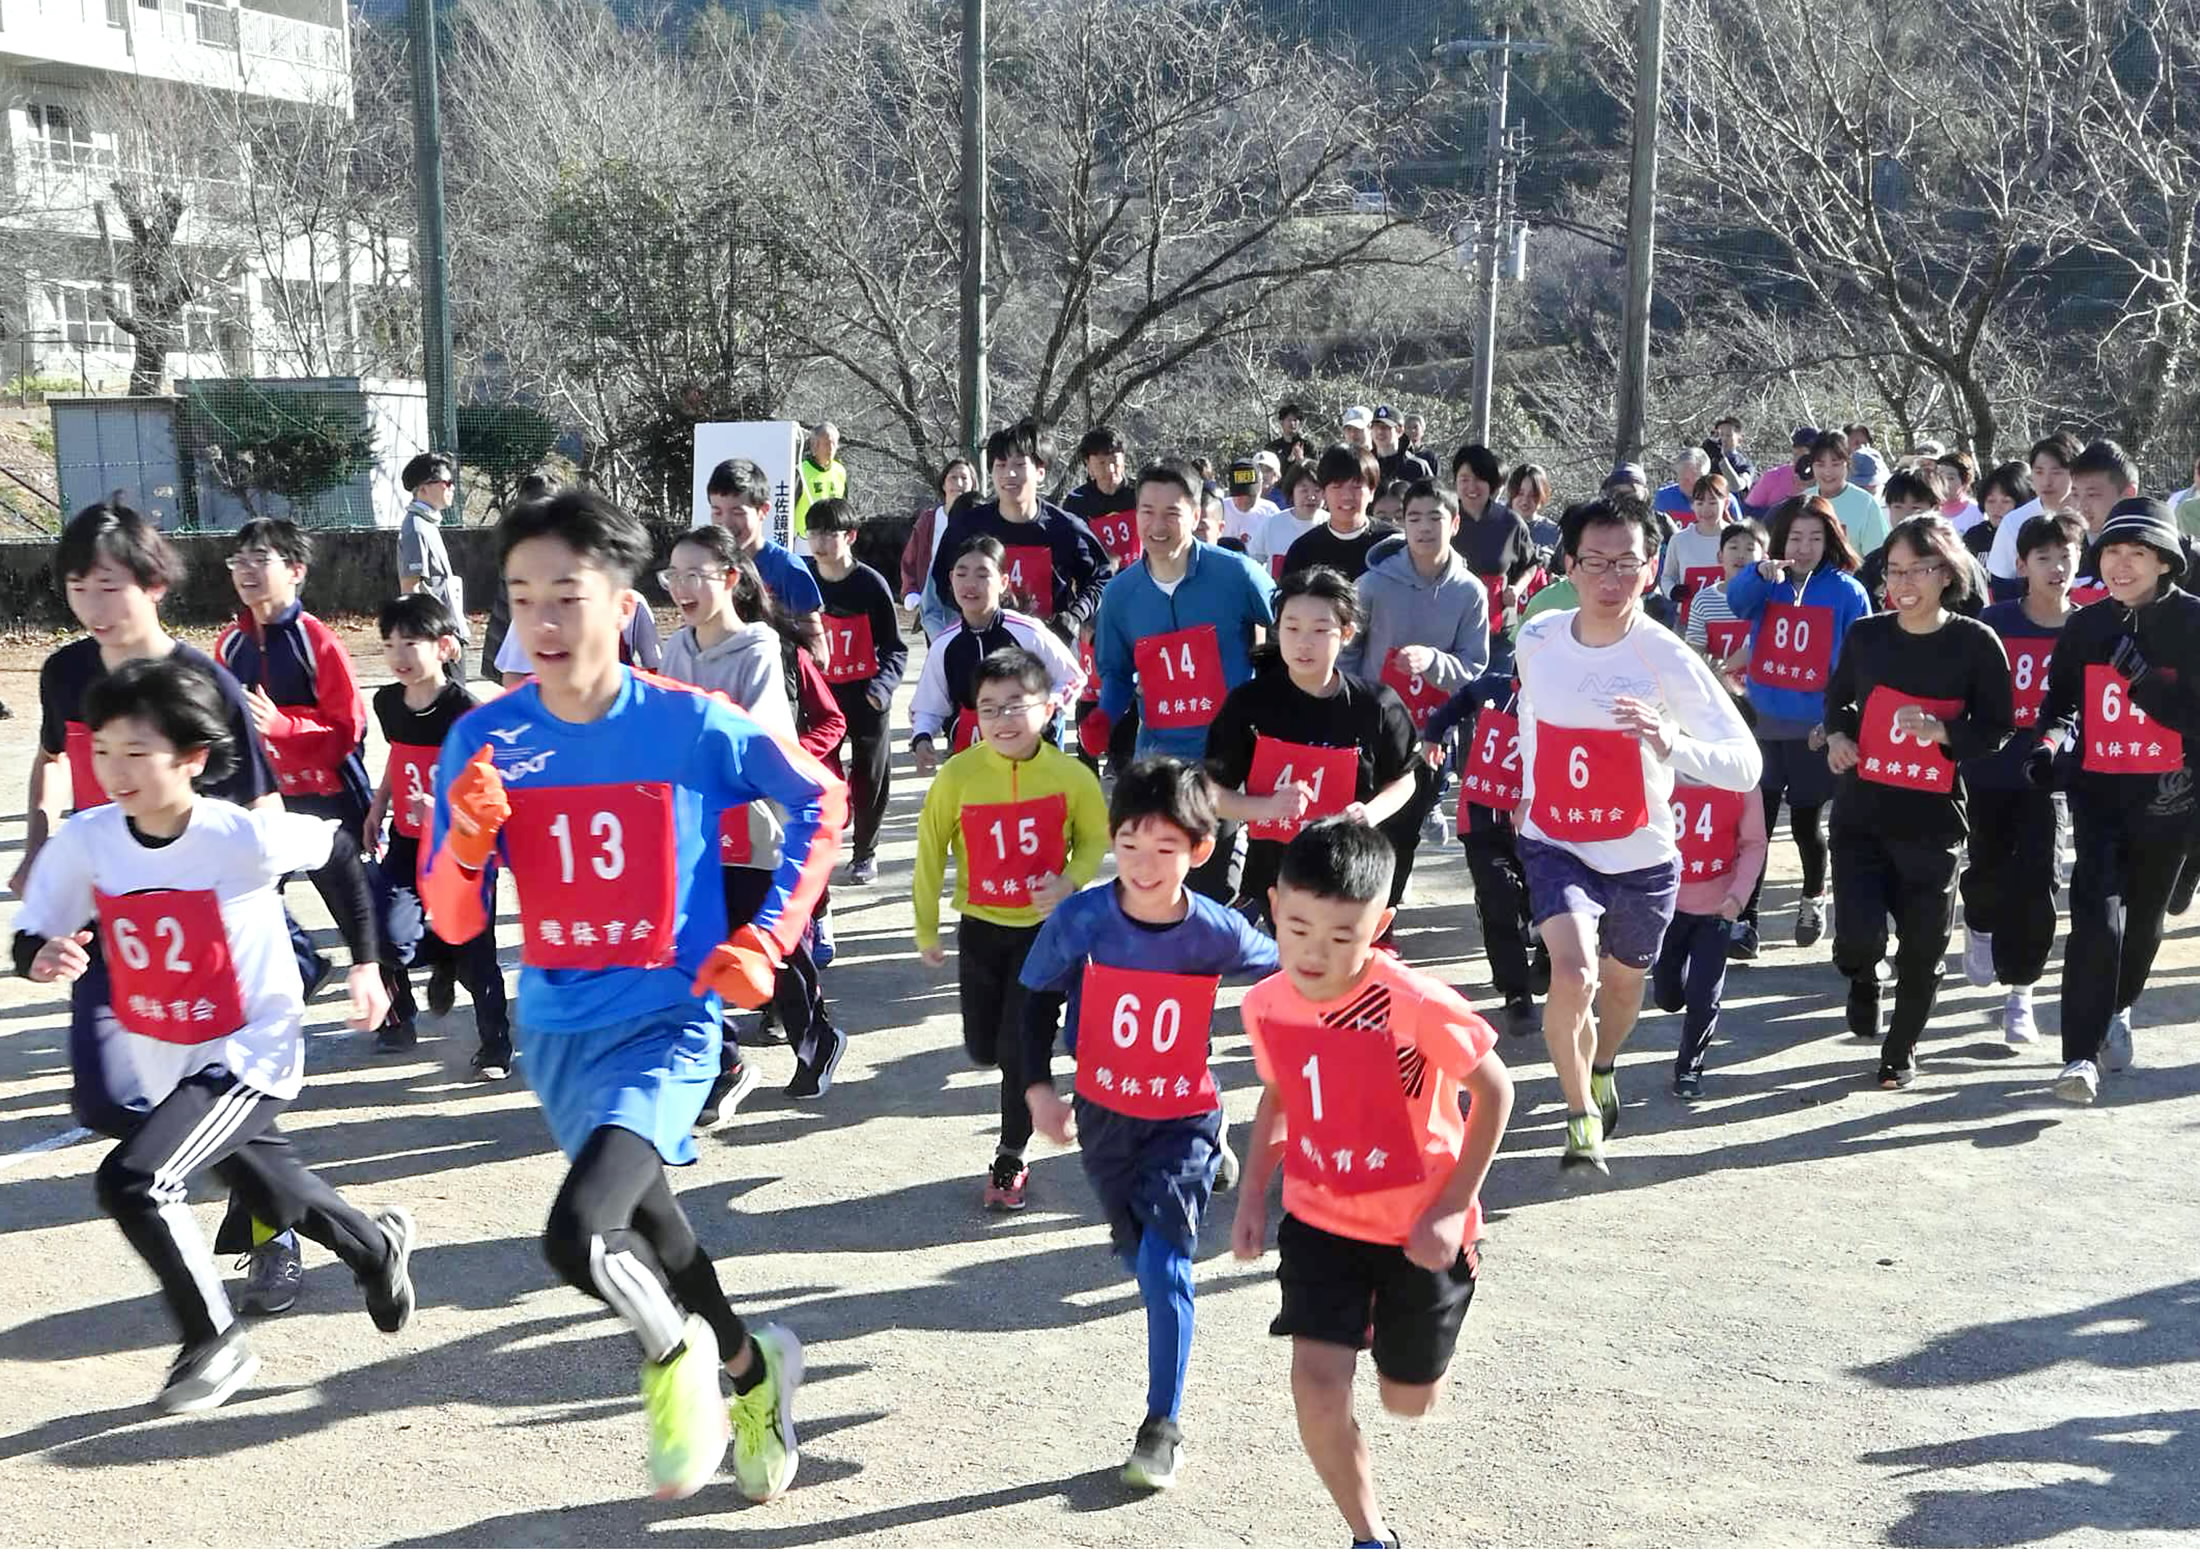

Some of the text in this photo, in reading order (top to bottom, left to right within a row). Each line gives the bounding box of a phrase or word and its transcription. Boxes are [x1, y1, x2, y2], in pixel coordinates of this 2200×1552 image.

[1104, 522, 1130, 545] 33
[826, 630, 853, 657] 17
[1775, 617, 1809, 652] 80
[821, 661, 866, 676] 体育会
[1159, 643, 1196, 681] 14
[1763, 660, 1817, 681] 鏡体育会
[1158, 697, 1214, 715] 鏡体育会
[2102, 682, 2146, 725] 64
[1889, 709, 1937, 748] 8
[1482, 728, 1521, 772] 52
[1569, 745, 1590, 789] 6
[1865, 757, 1941, 782] 鏡体育会
[1273, 763, 1325, 803] 41
[990, 817, 1039, 860] 15
[1672, 801, 1713, 843] 84
[550, 811, 625, 883] 13
[112, 916, 193, 974] 62
[1112, 992, 1182, 1053] 60
[1302, 1055, 1324, 1122] 1
